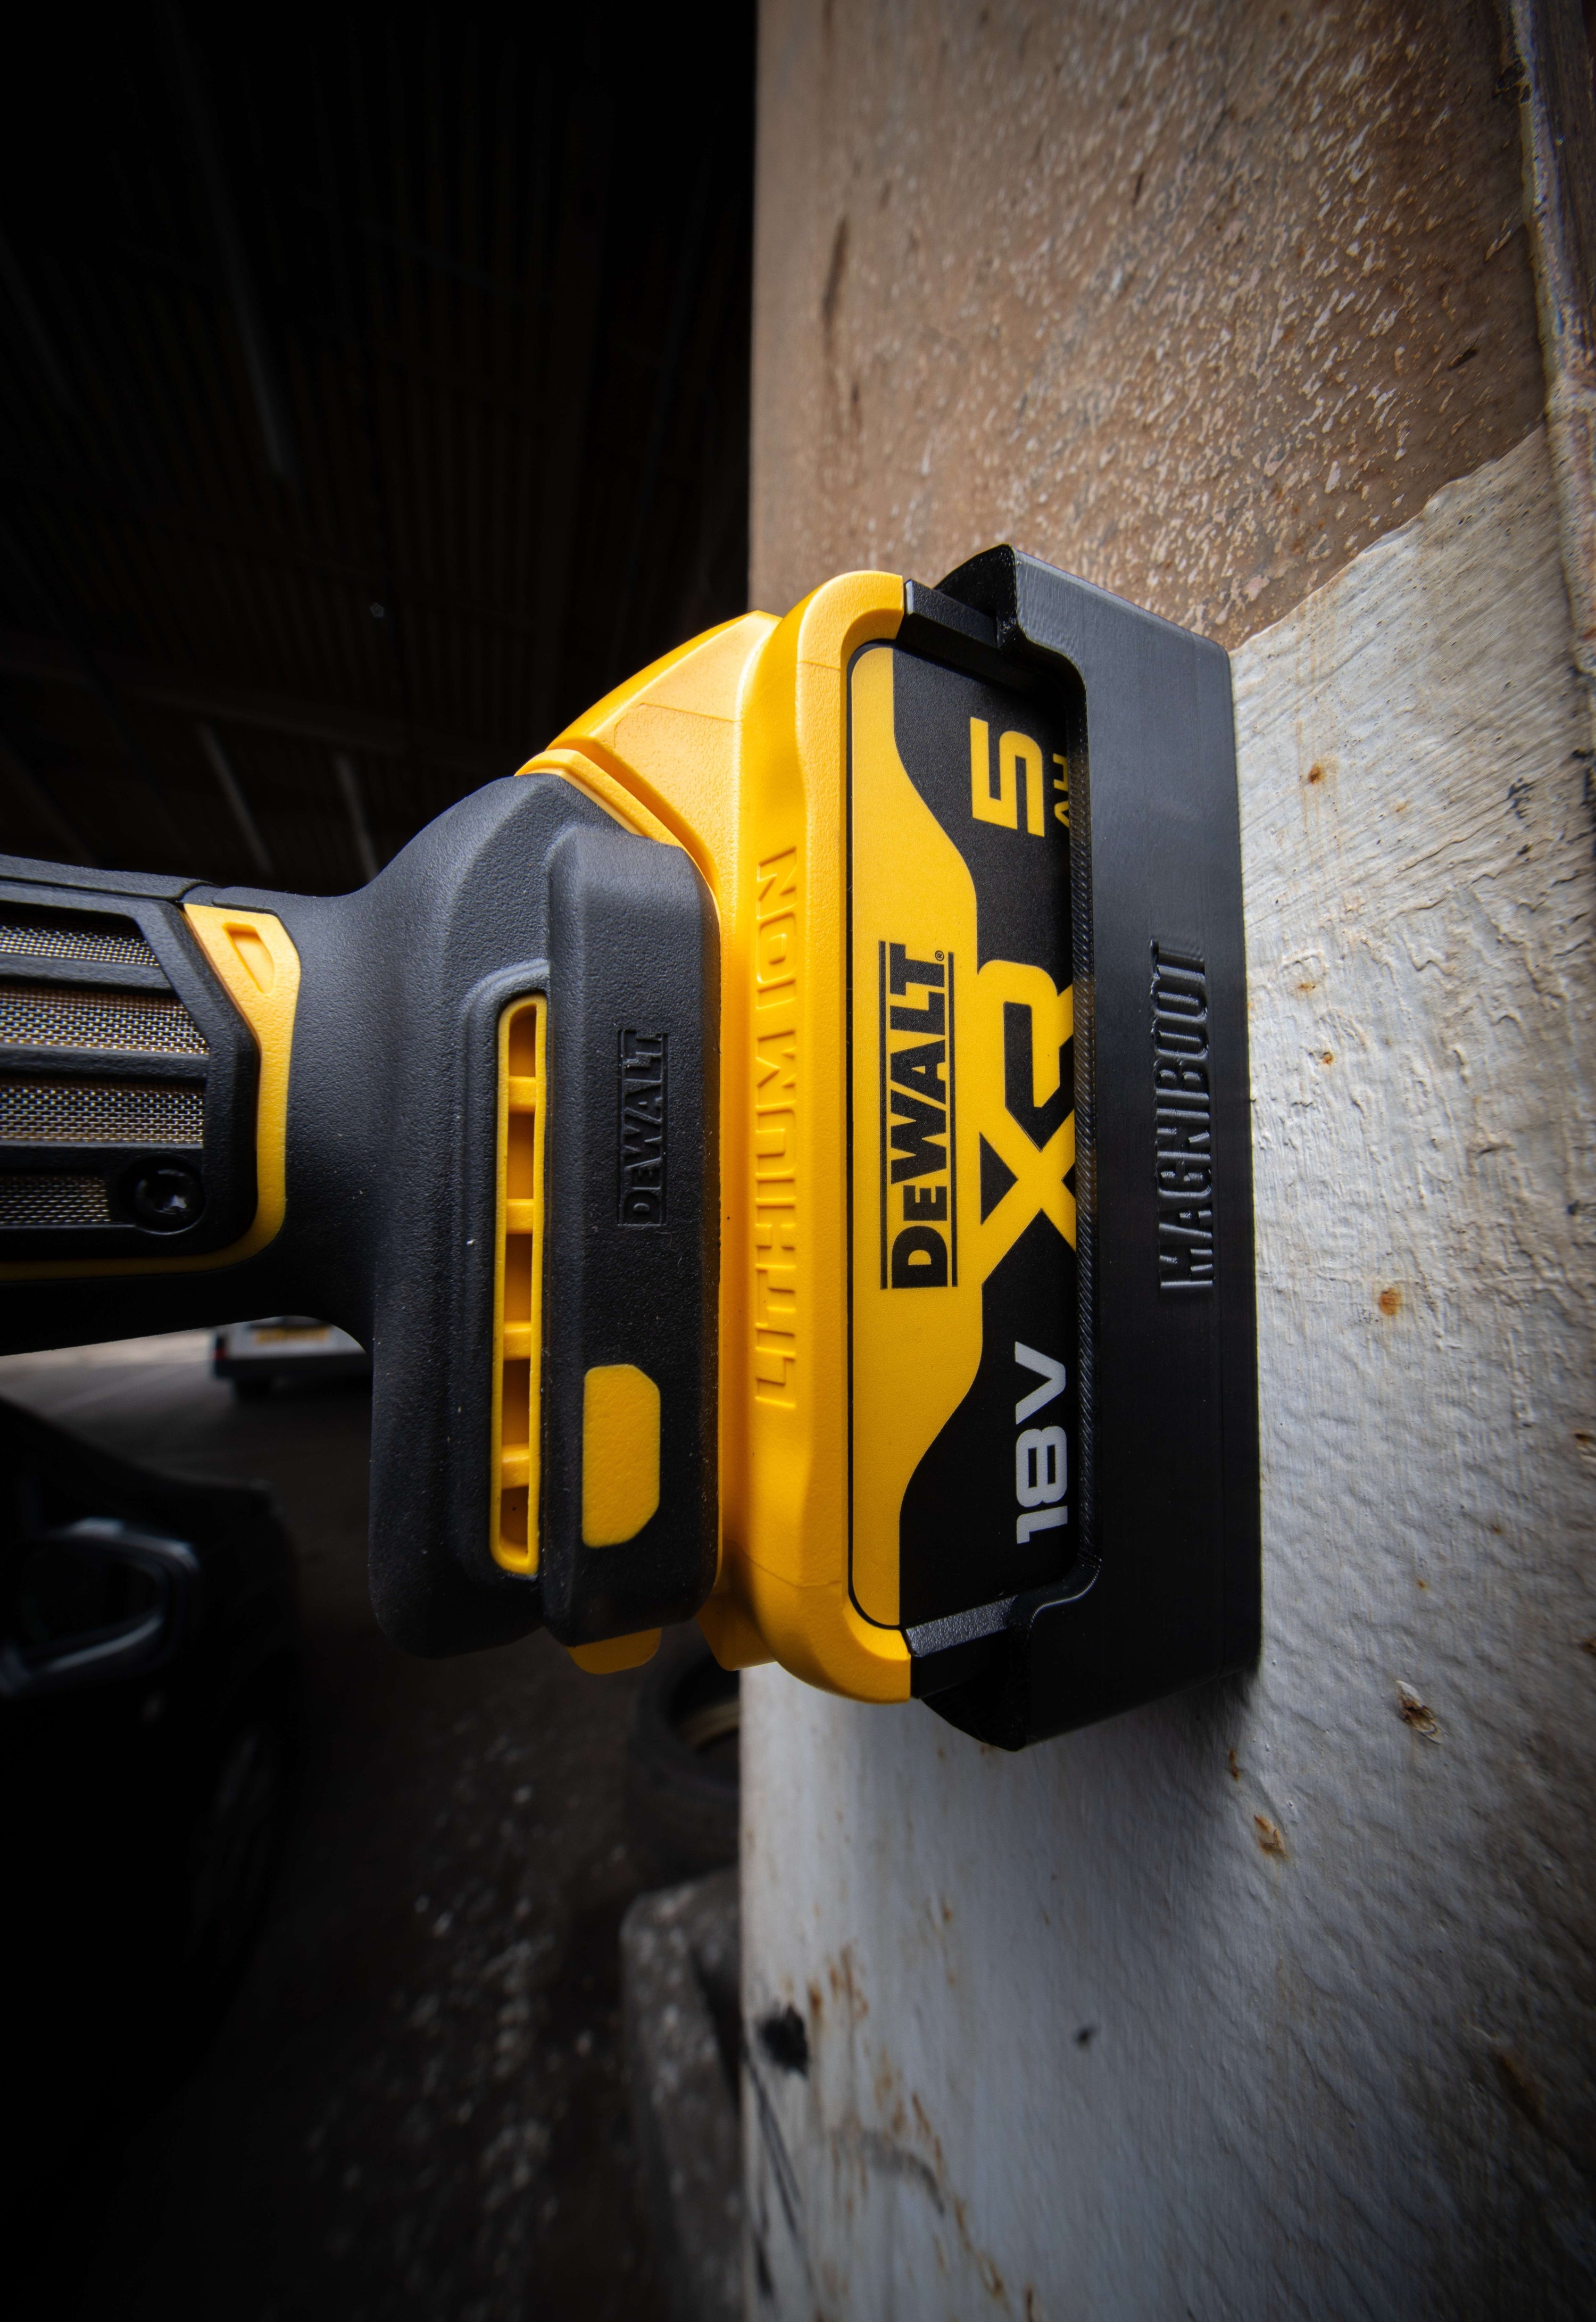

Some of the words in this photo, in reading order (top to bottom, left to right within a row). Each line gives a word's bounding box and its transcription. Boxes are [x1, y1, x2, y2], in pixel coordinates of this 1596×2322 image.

[970, 717, 1044, 837] 5
[756, 847, 797, 1009] ION
[624, 1030, 663, 1225] DEWALT
[977, 960, 1076, 1284] XR
[1150, 939, 1213, 1290] MAGNIBOOT
[756, 1030, 796, 1409] LITHIUM
[1015, 1342, 1068, 1544] 18V
